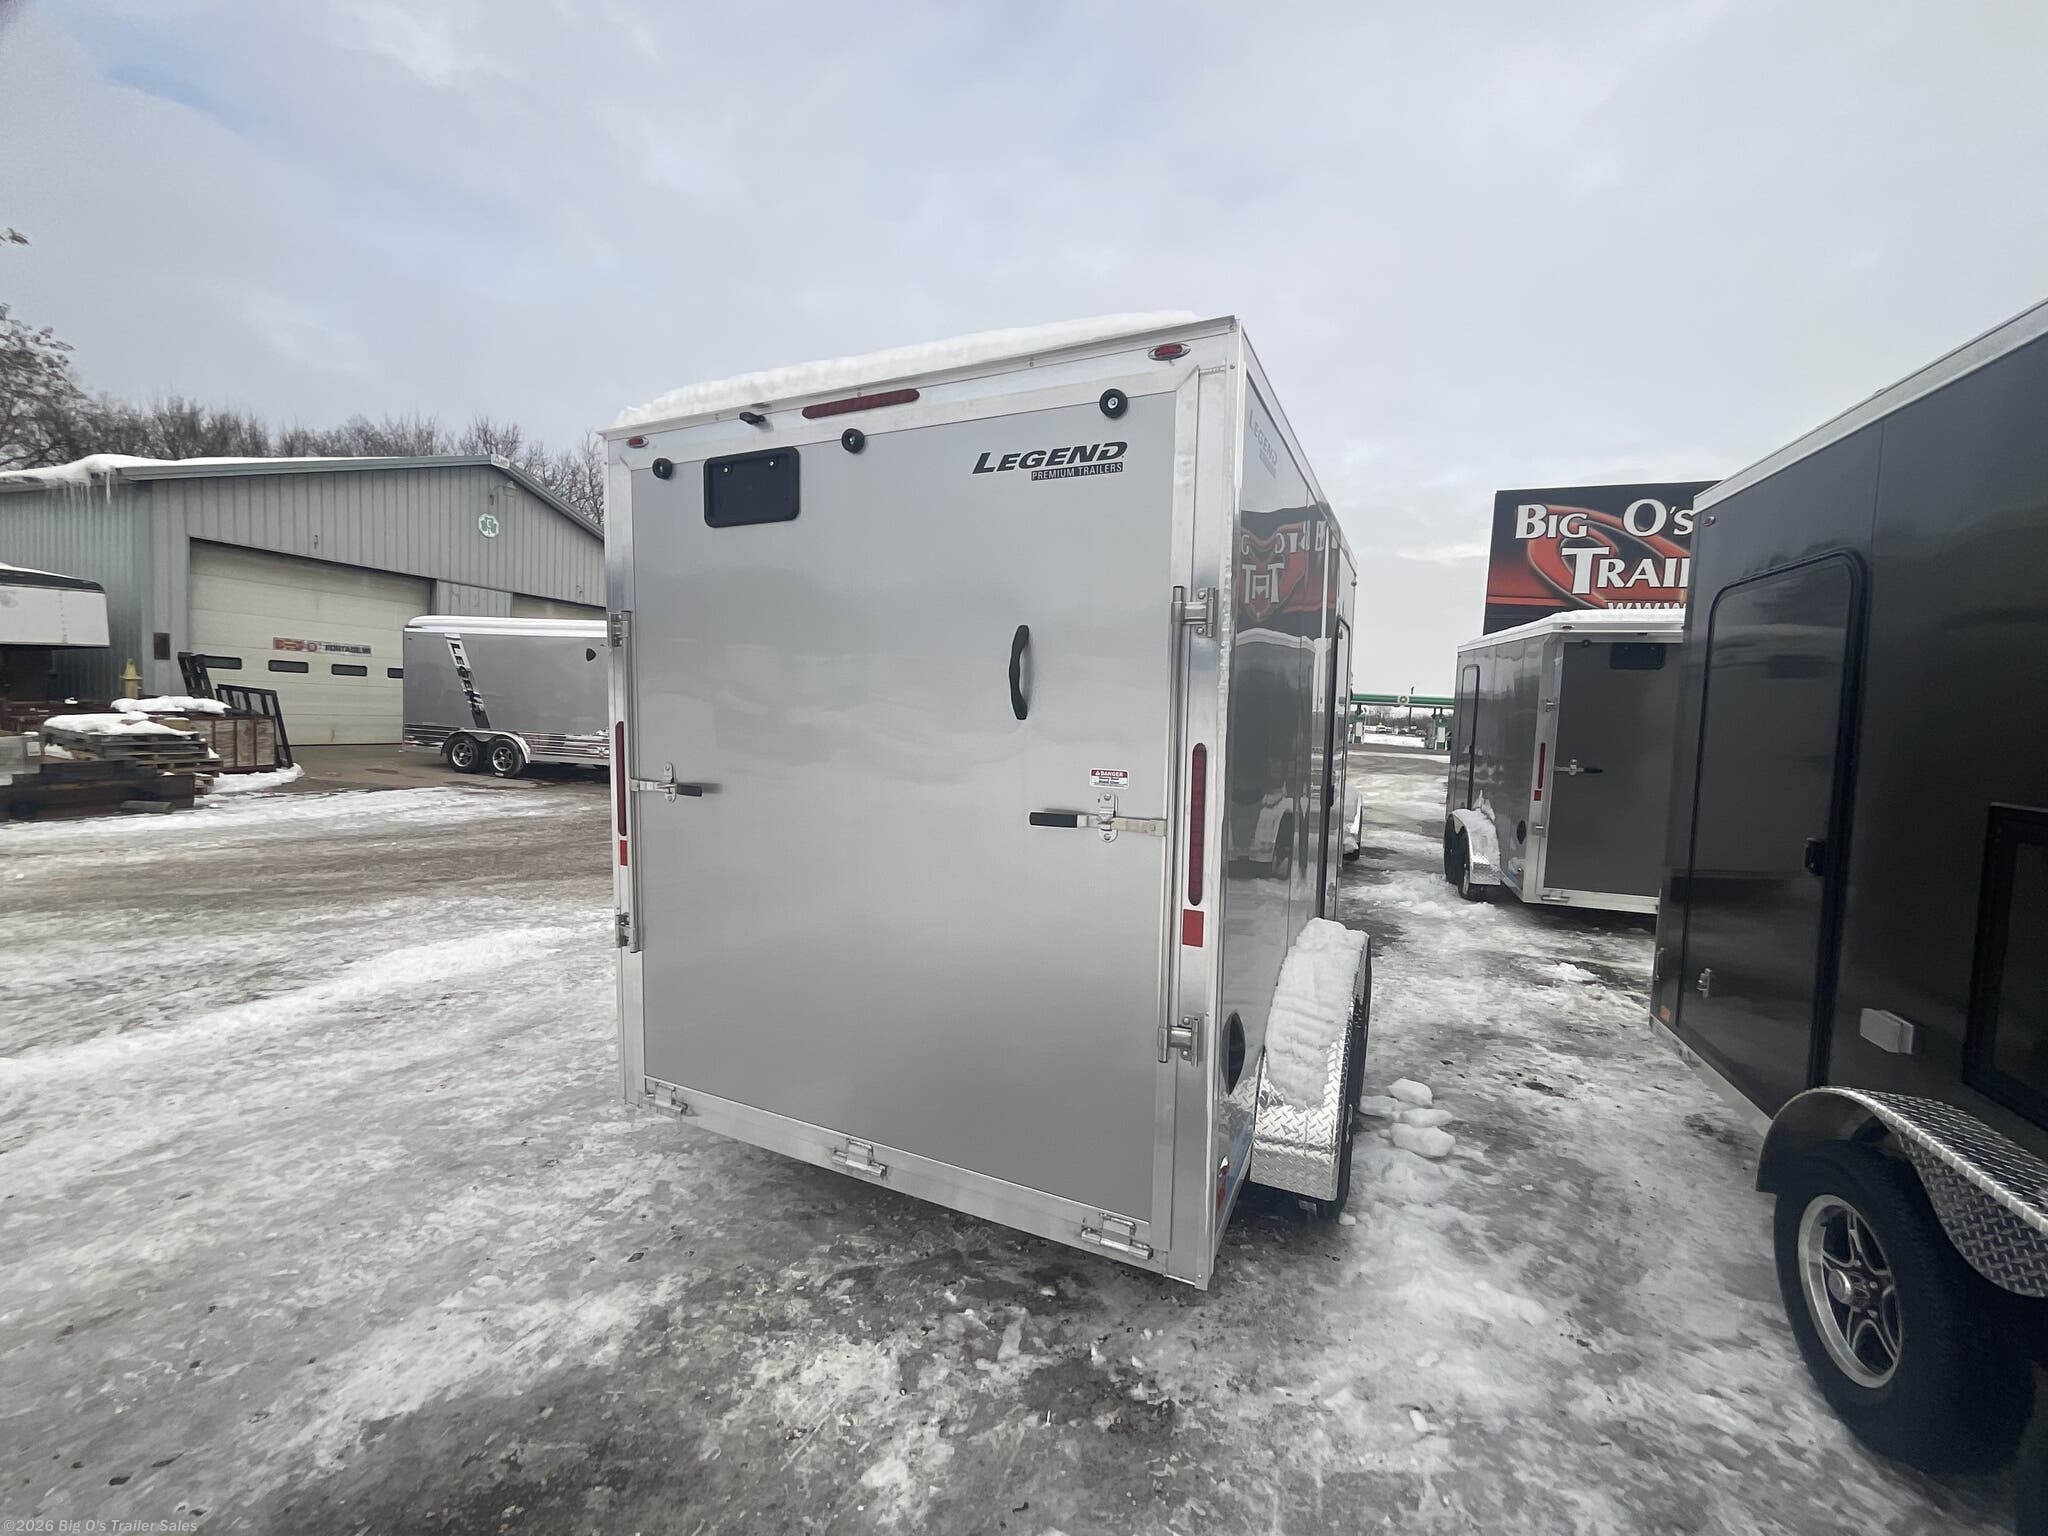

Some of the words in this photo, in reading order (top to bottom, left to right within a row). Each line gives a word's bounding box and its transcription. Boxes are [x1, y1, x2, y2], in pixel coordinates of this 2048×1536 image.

[1249, 409, 1278, 466] LEGEND
[972, 441, 1128, 474] LEGEND
[1032, 467, 1075, 480] PREMIUM
[1078, 462, 1123, 475] TRAILERS
